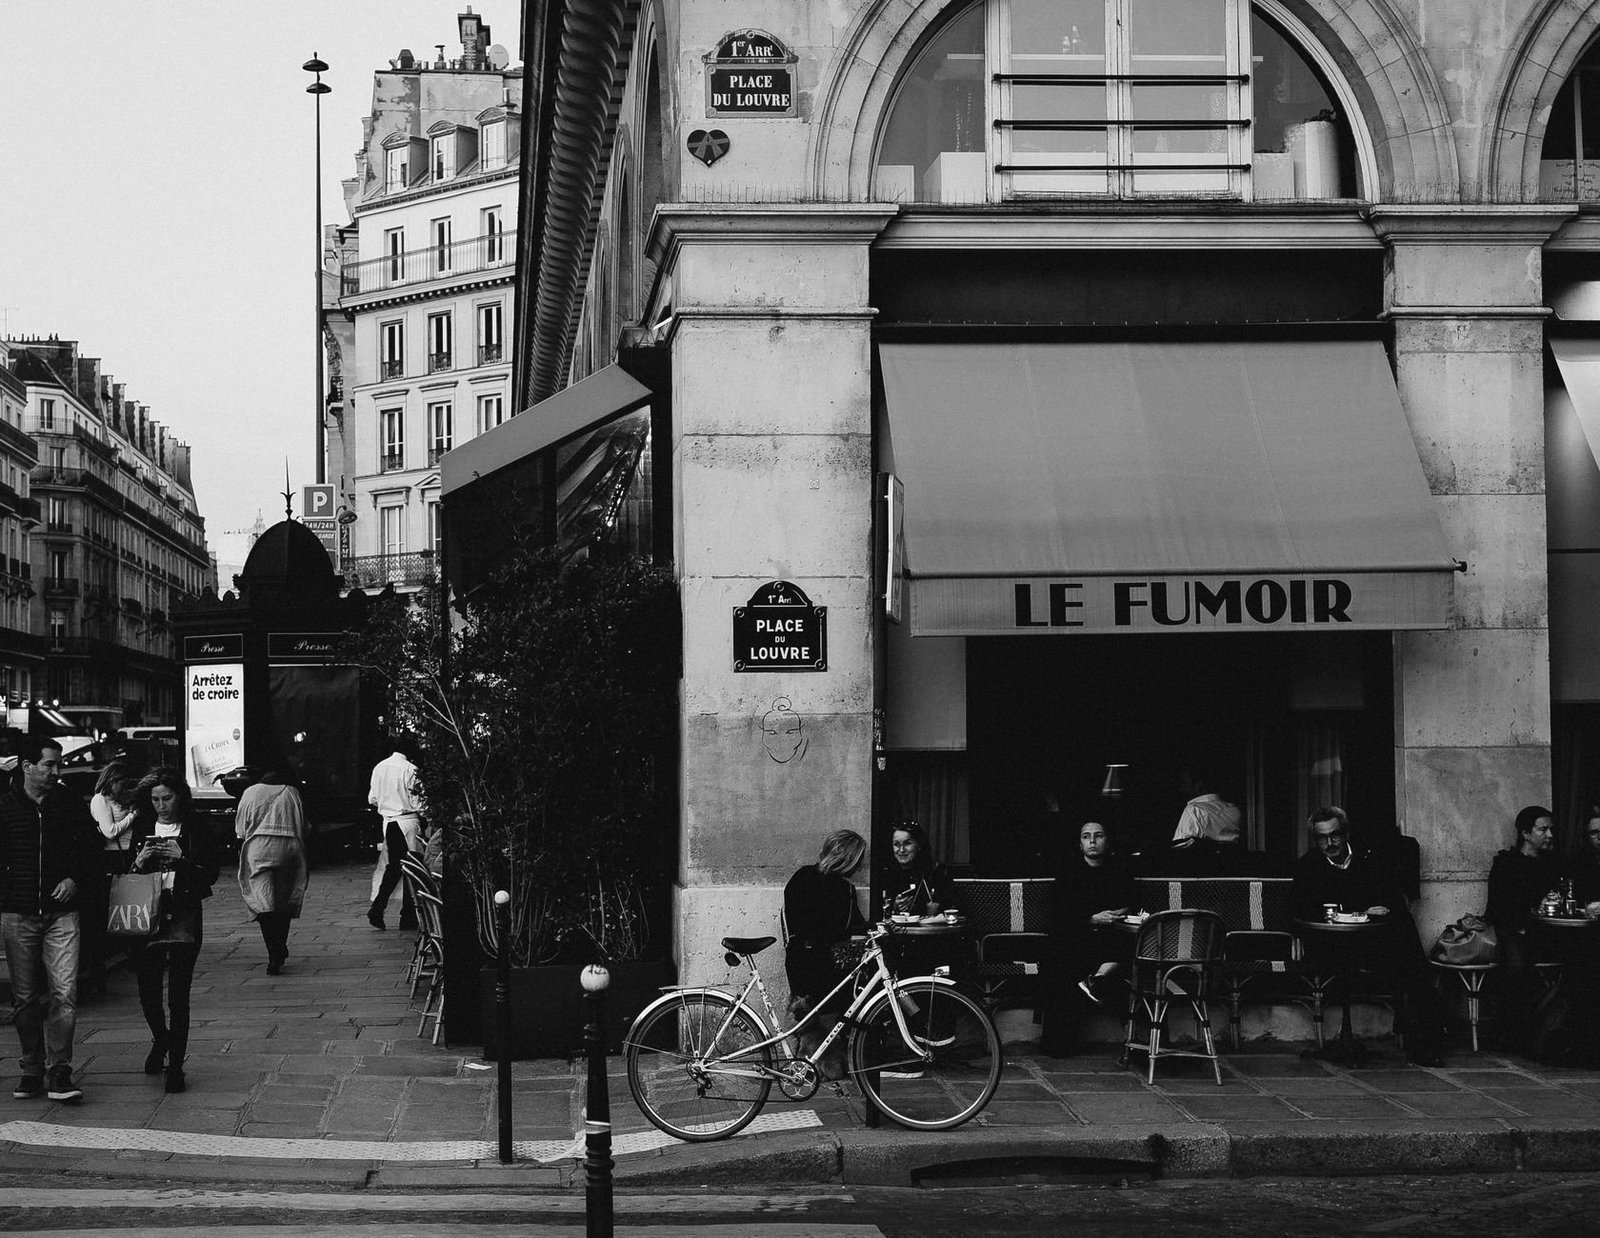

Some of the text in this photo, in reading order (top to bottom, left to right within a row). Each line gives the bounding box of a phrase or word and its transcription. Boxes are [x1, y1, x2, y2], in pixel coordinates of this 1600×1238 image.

[729, 75, 773, 88] PLACE
[713, 93, 790, 106] DU LOUVRE
[313, 491, 327, 513] P
[1014, 579, 1353, 627] LE FUMOIR
[756, 619, 804, 632] PLACE
[200, 642, 225, 652] Presse
[294, 640, 331, 651] Presse
[750, 647, 810, 660] LOUVRE
[192, 673, 233, 687] Arrêtez
[192, 687, 239, 700] de croire
